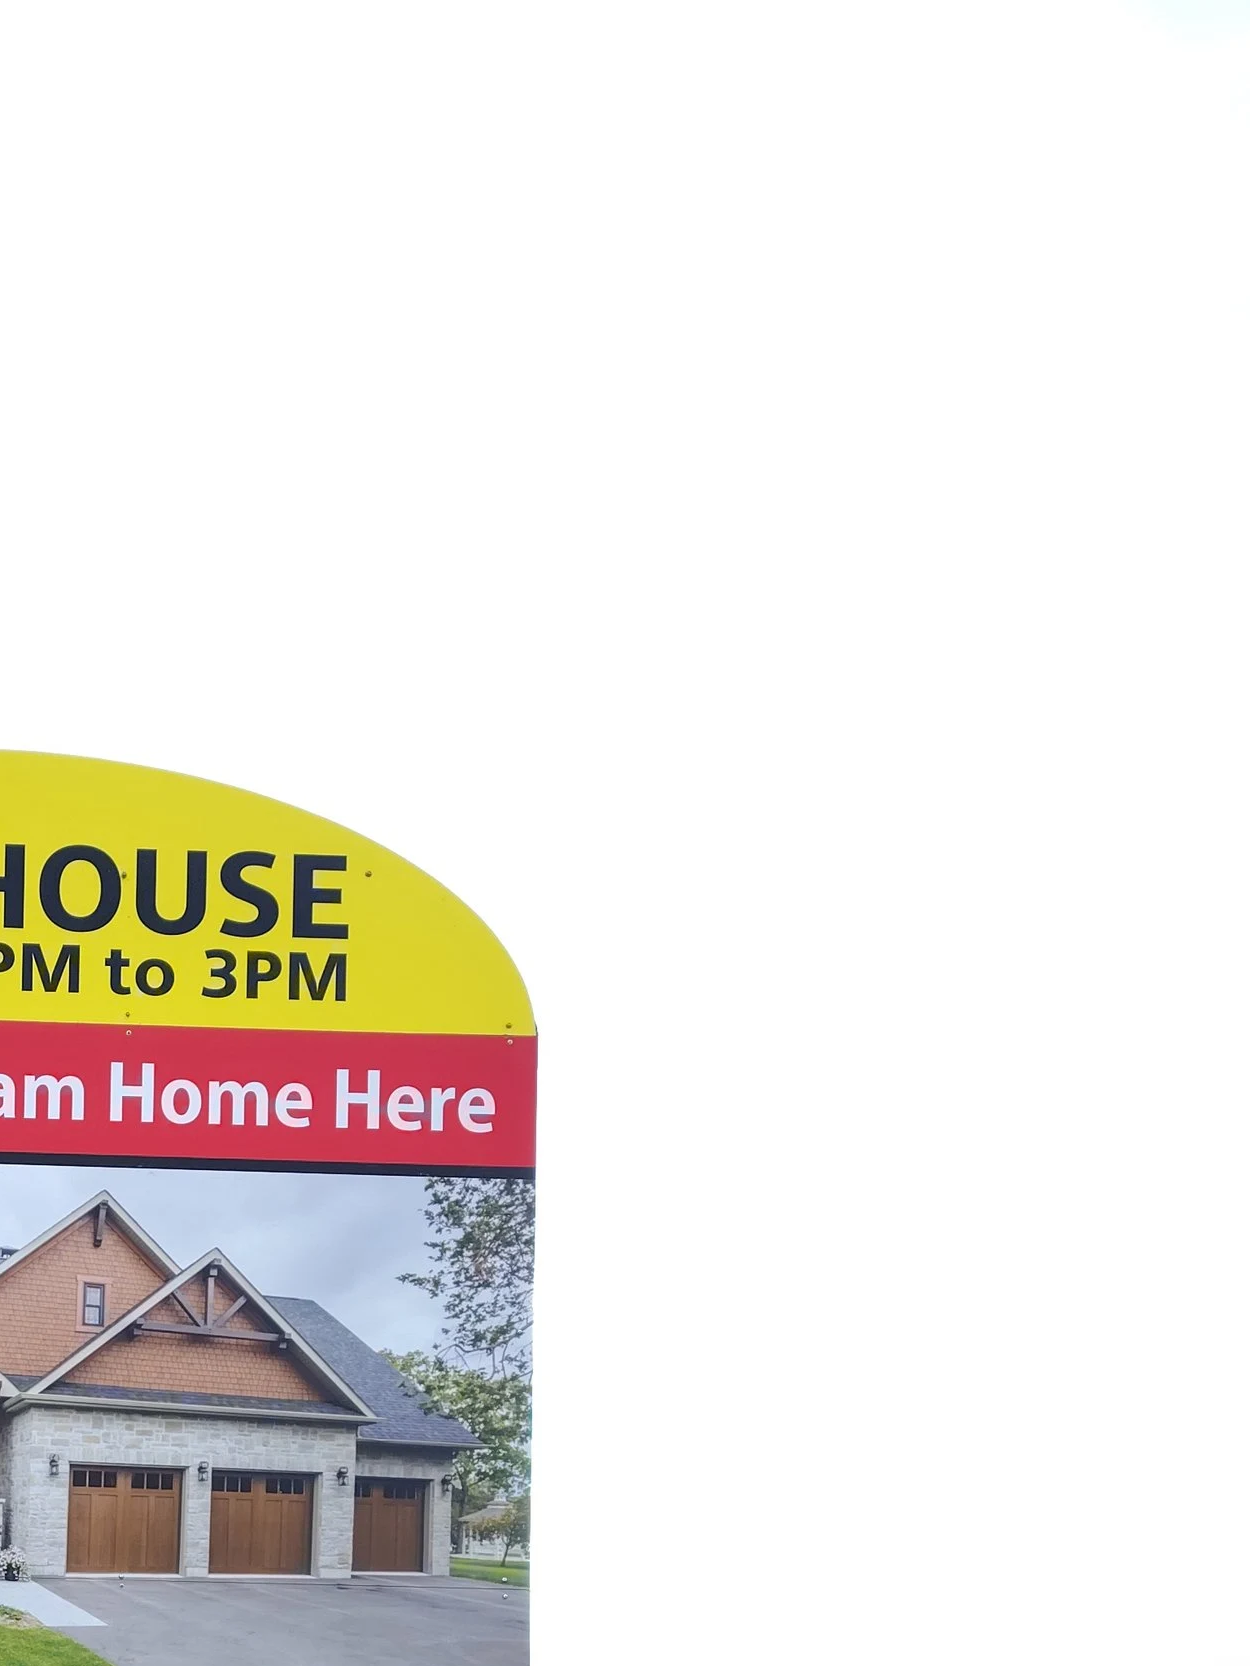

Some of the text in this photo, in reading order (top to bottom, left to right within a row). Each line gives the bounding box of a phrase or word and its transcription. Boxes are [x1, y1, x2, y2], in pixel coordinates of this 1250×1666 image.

[104, 948, 175, 997] to
[201, 948, 348, 1002] 3PM
[109, 1061, 313, 1129] Home
[335, 1068, 496, 1134] Here
